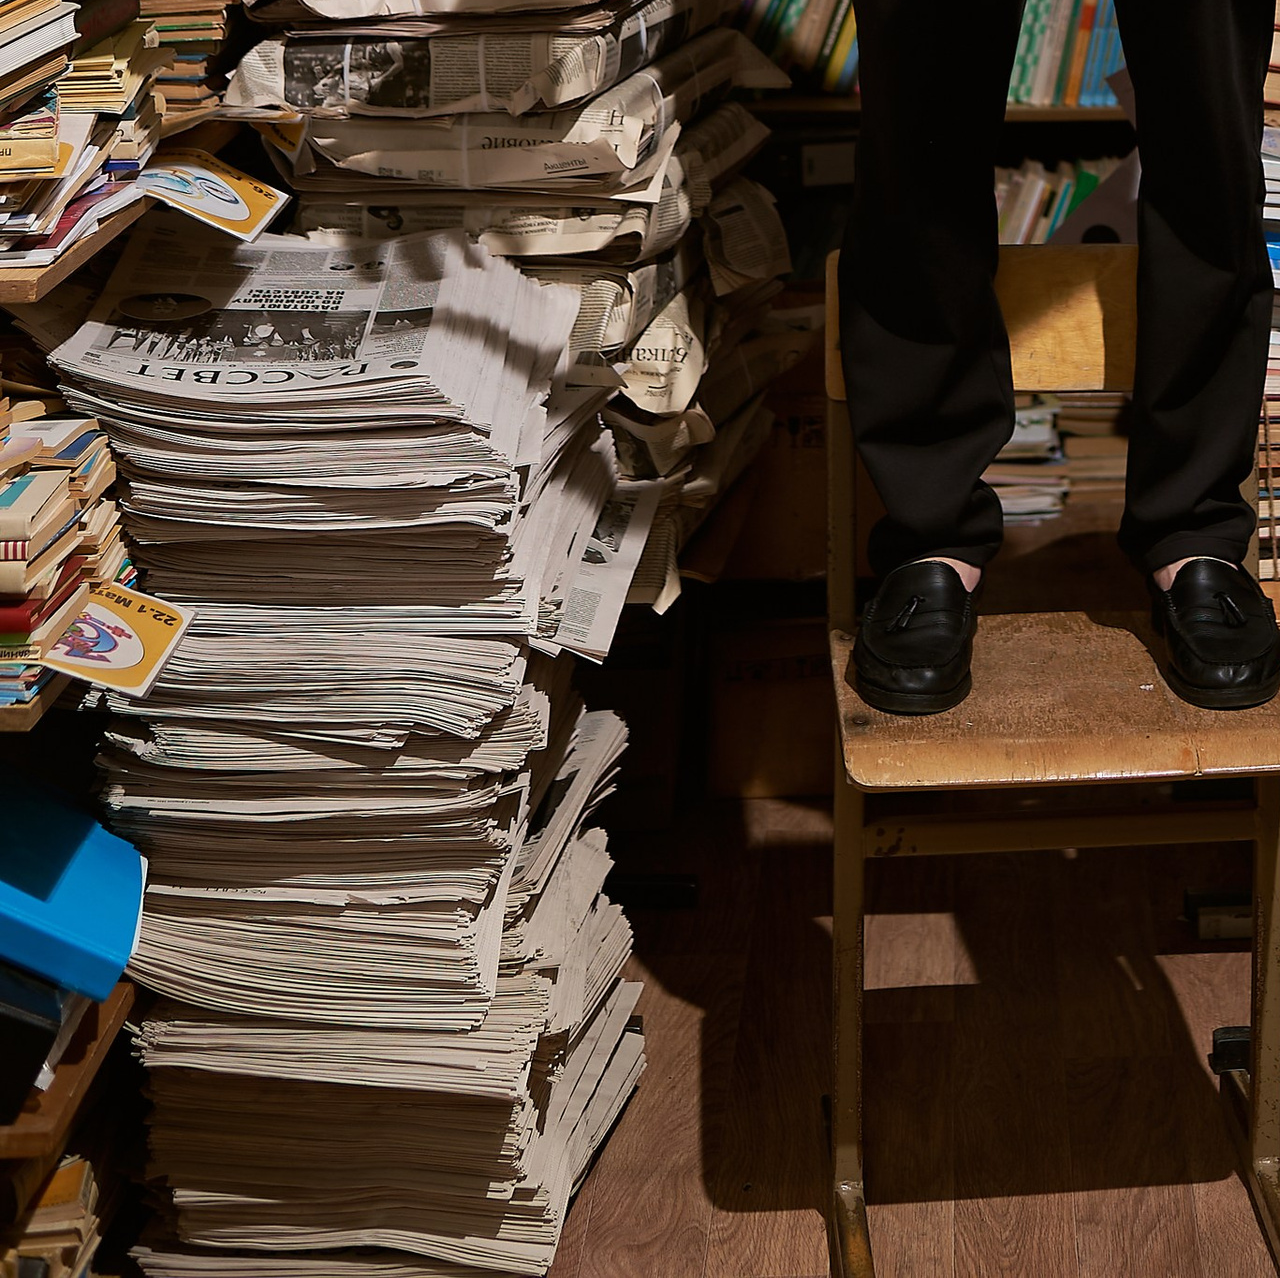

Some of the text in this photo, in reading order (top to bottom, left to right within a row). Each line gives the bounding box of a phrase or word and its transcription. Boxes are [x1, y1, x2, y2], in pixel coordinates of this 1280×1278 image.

[543, 158, 588, 171] Акценты
[258, 303, 340, 311] РАБОТАЮТ
[125, 362, 369, 388] РАССВЕТ
[136, 605, 178, 627] 22.1
